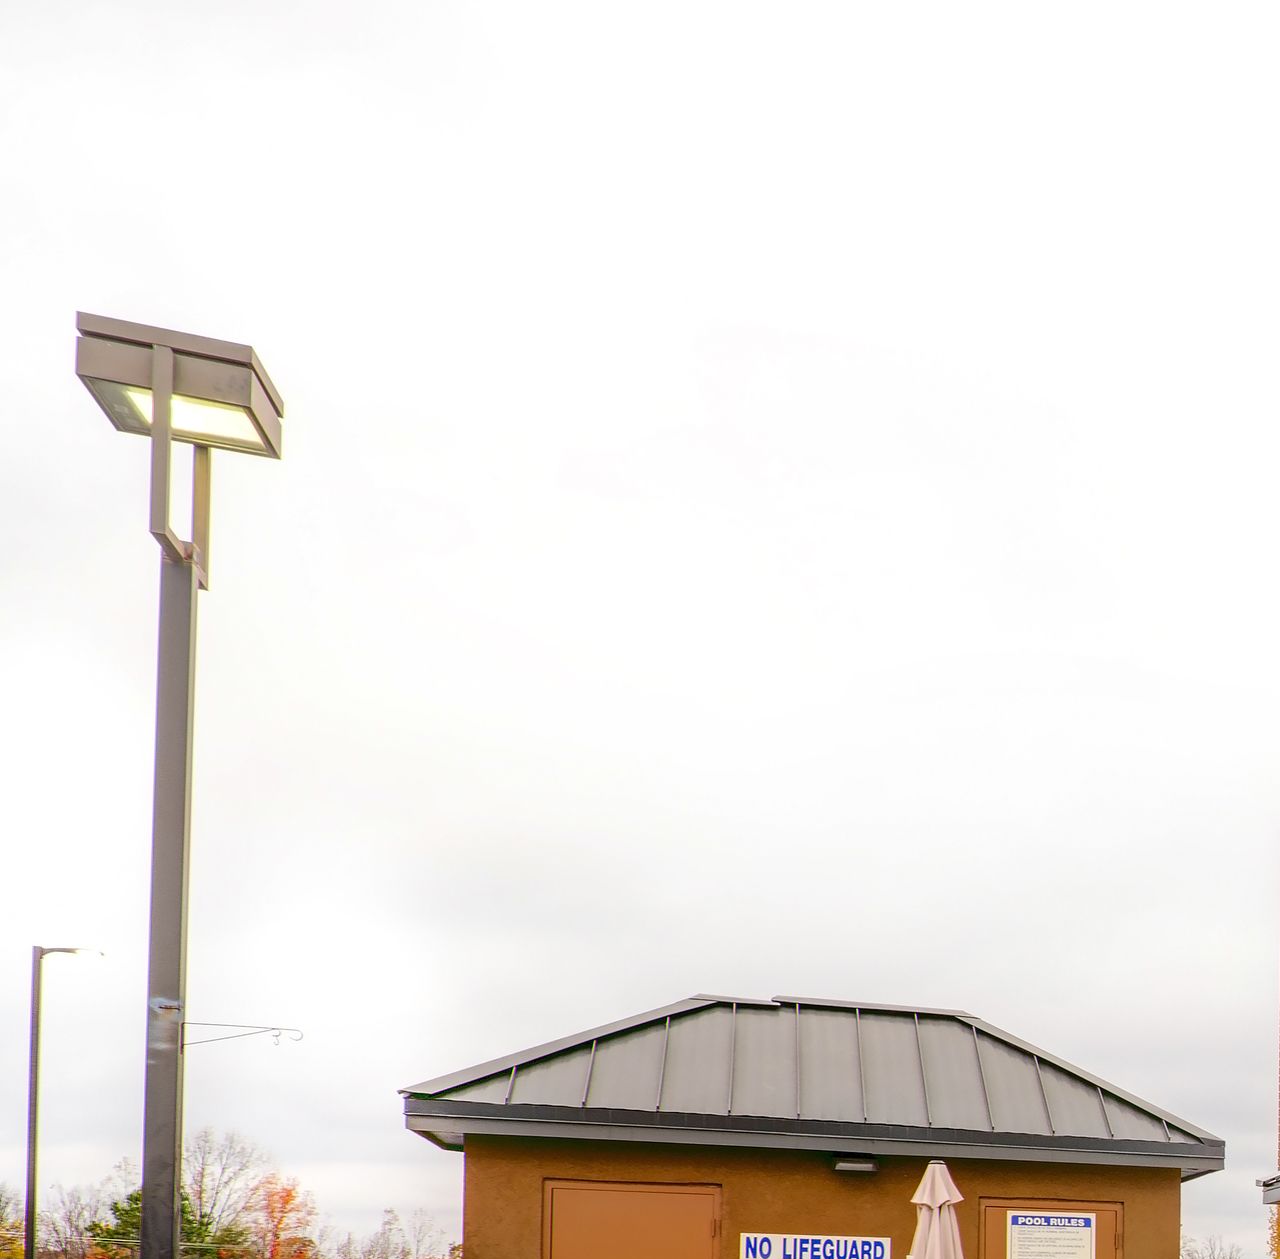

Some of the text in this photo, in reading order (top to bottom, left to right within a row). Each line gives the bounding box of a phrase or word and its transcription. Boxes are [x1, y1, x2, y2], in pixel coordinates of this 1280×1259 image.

[1018, 1216, 1085, 1227] POOL RULES
[745, 1236, 772, 1259] NO
